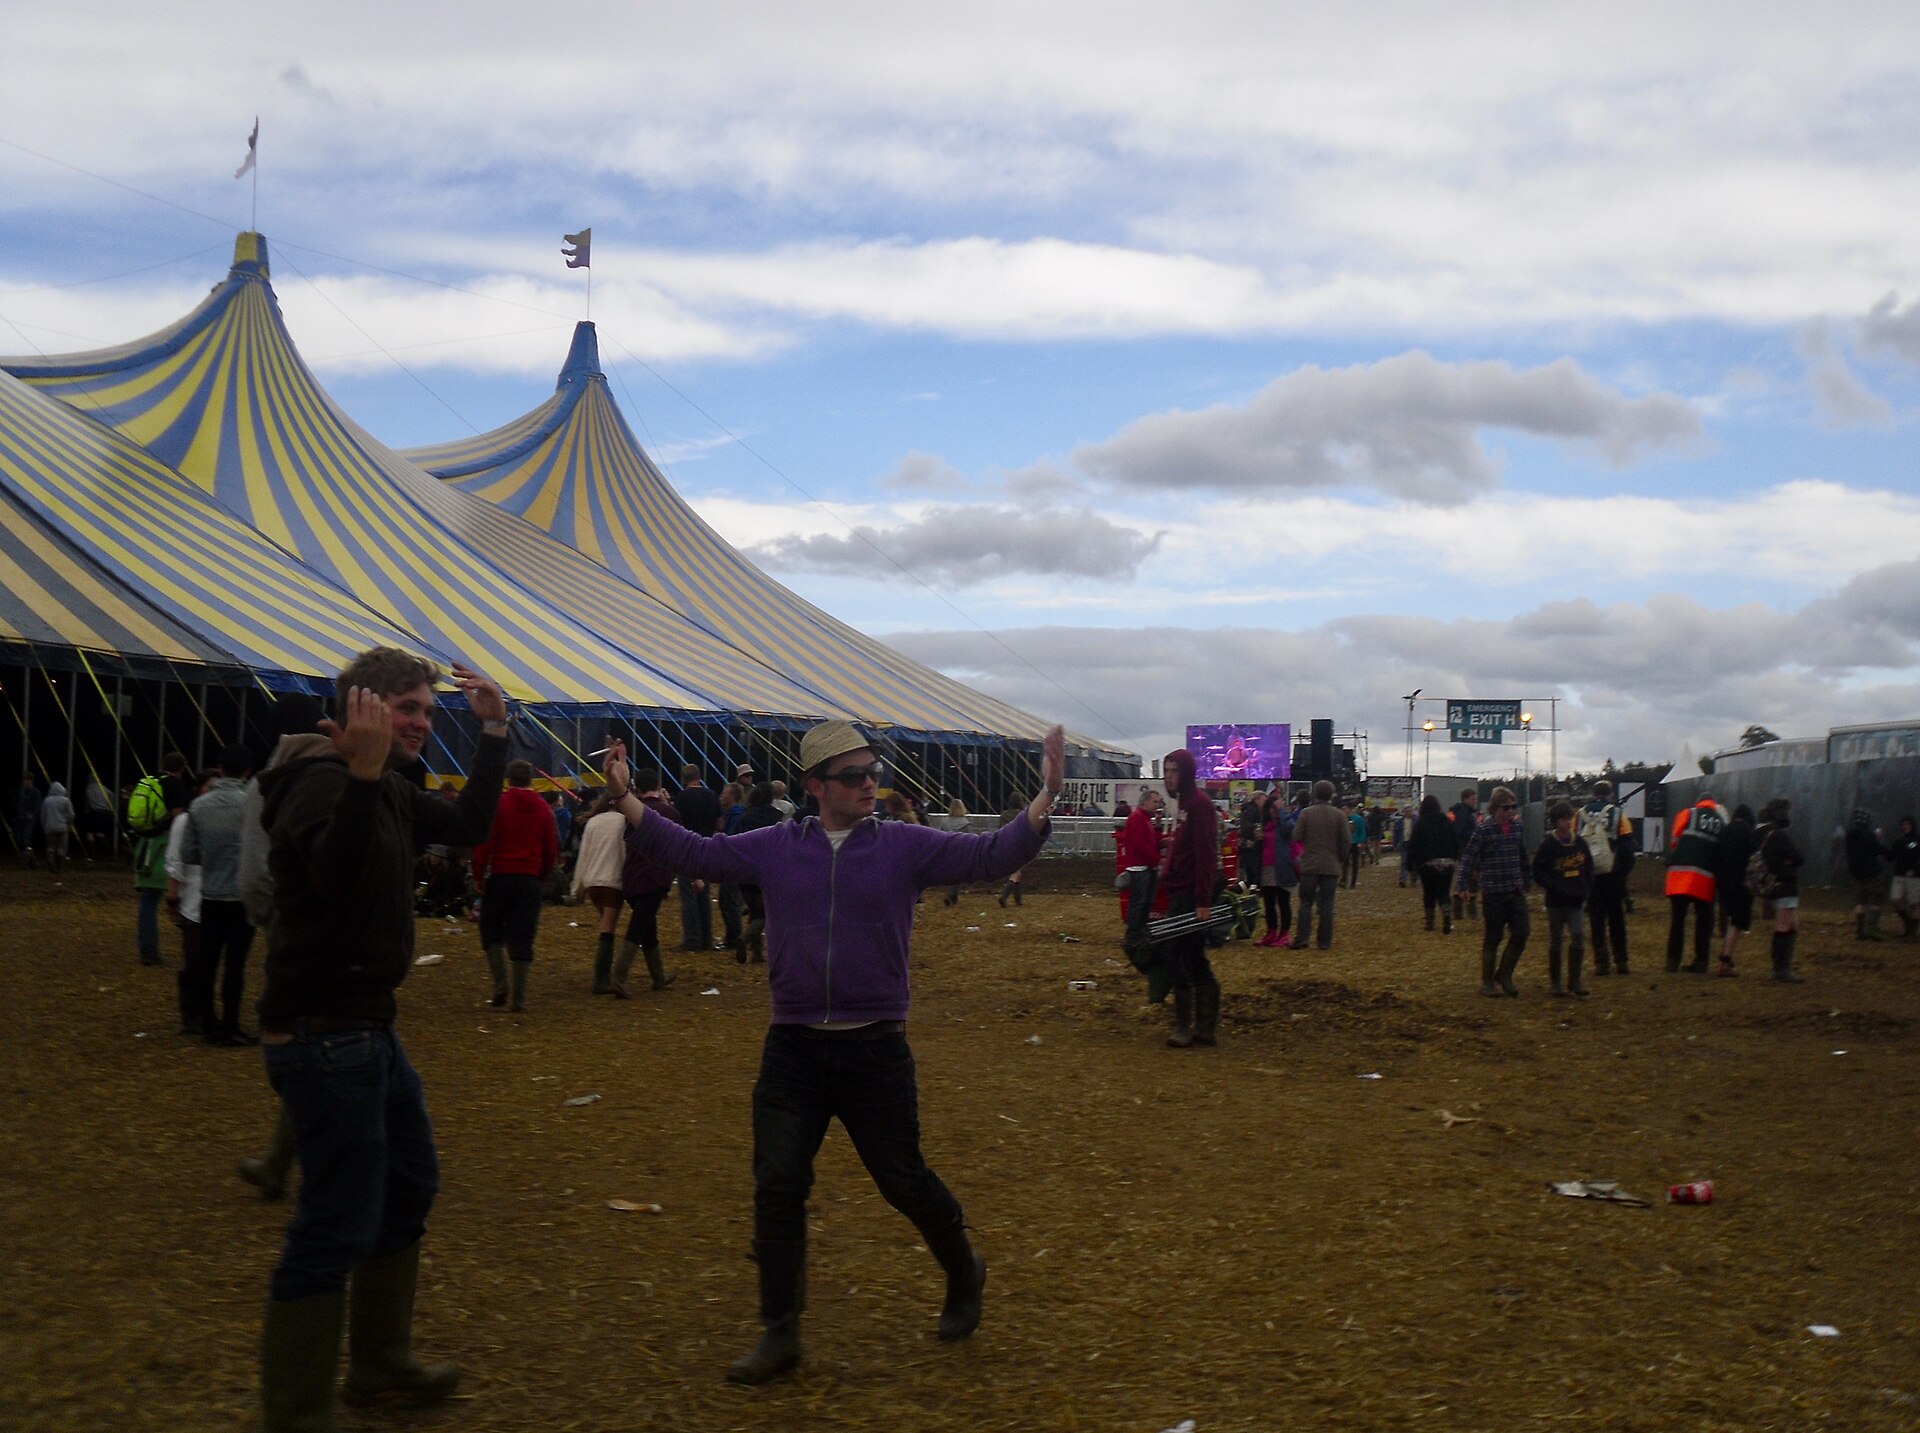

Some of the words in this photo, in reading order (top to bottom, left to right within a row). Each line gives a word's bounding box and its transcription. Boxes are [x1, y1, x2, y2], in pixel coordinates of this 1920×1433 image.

[1467, 704, 1518, 713] EMERGENCY
[1470, 713, 1502, 726] EXIT
[1505, 713, 1516, 726] H
